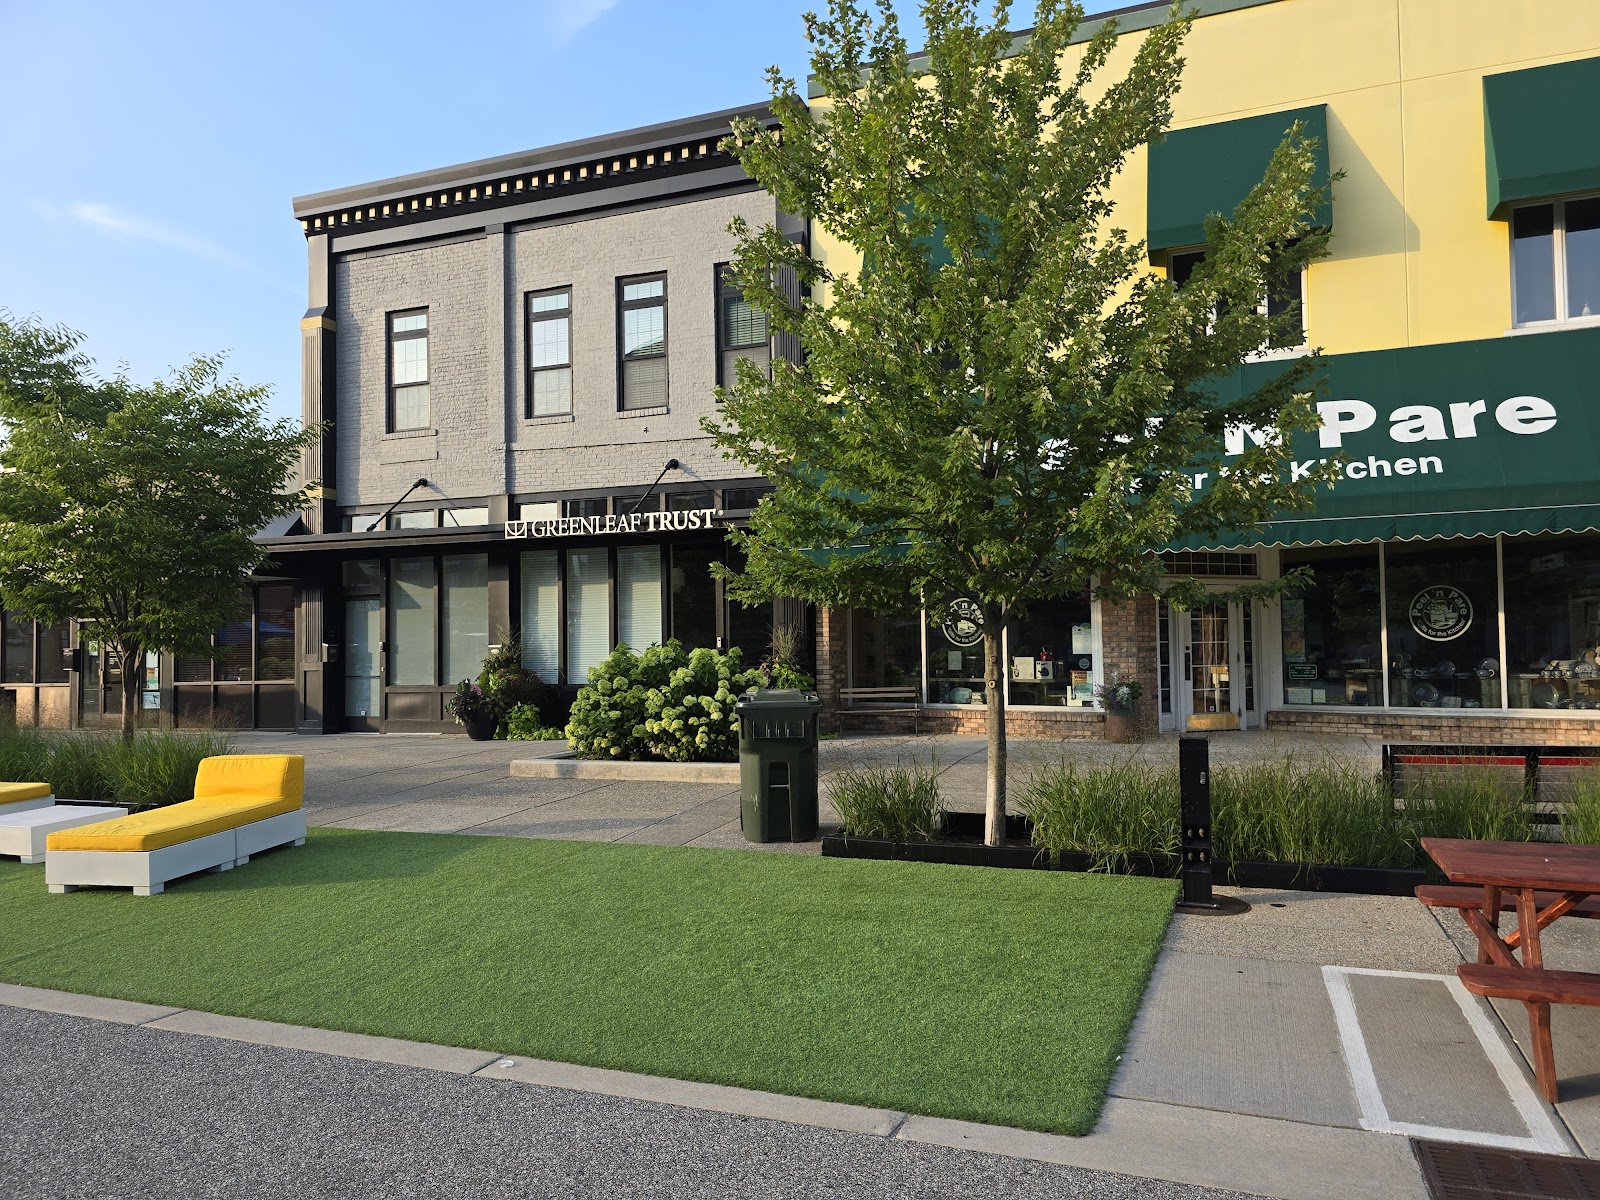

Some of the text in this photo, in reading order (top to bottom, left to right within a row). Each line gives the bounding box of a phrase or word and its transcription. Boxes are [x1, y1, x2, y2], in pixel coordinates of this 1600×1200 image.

[1316, 395, 1558, 448] Pare
[531, 508, 717, 538] GREENLEAF TRUST
[1412, 592, 1431, 617] Peel
[1448, 590, 1468, 615] Pare
